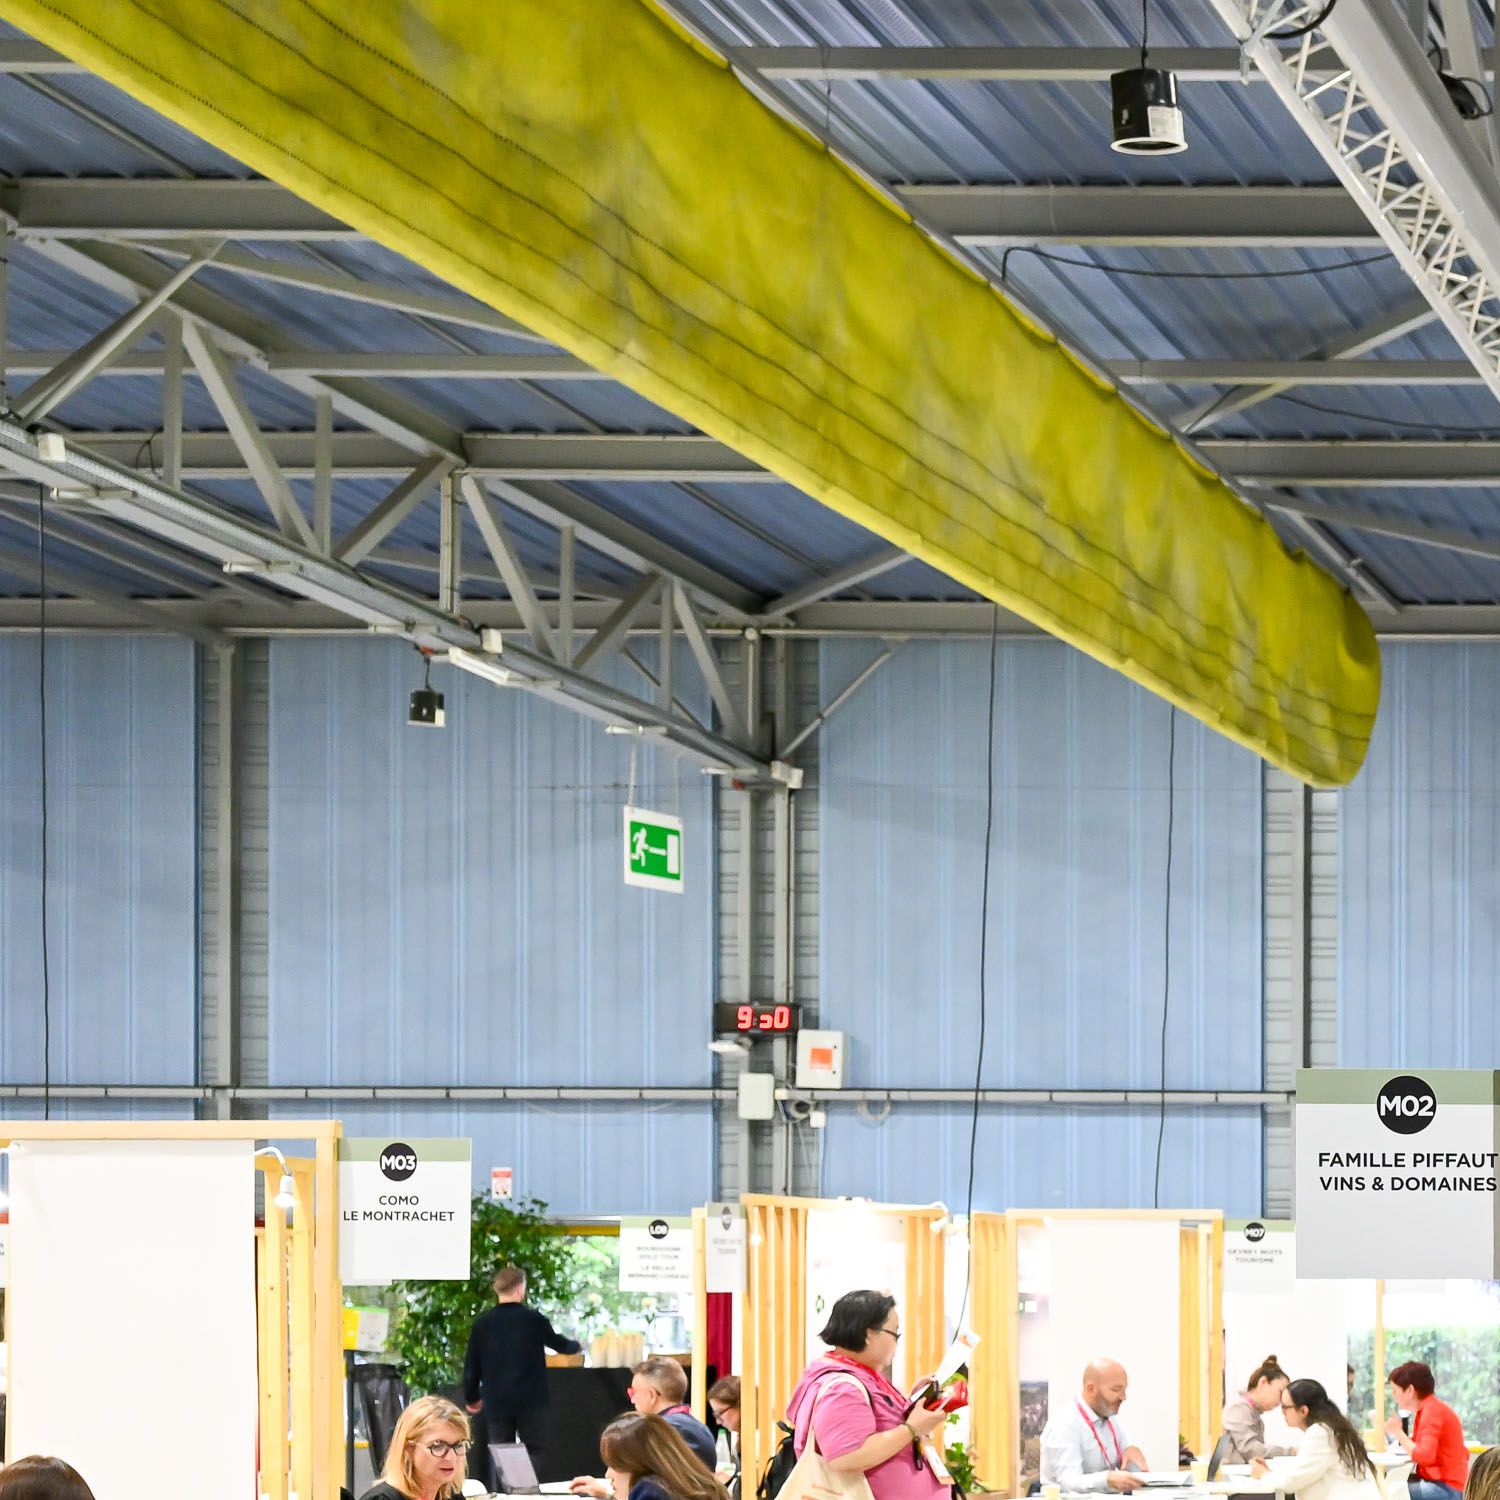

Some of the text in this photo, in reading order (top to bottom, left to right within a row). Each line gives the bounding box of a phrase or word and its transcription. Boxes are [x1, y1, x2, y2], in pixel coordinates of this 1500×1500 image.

[1380, 1095, 1434, 1117] M02
[381, 1154, 417, 1171] M03
[1318, 1152, 1499, 1169] FAMILLE PIFFAUT
[1320, 1176, 1497, 1192] VINS & DOMAINES
[378, 1195, 419, 1206] COMO
[343, 1210, 455, 1222] LE MONTRACHET
